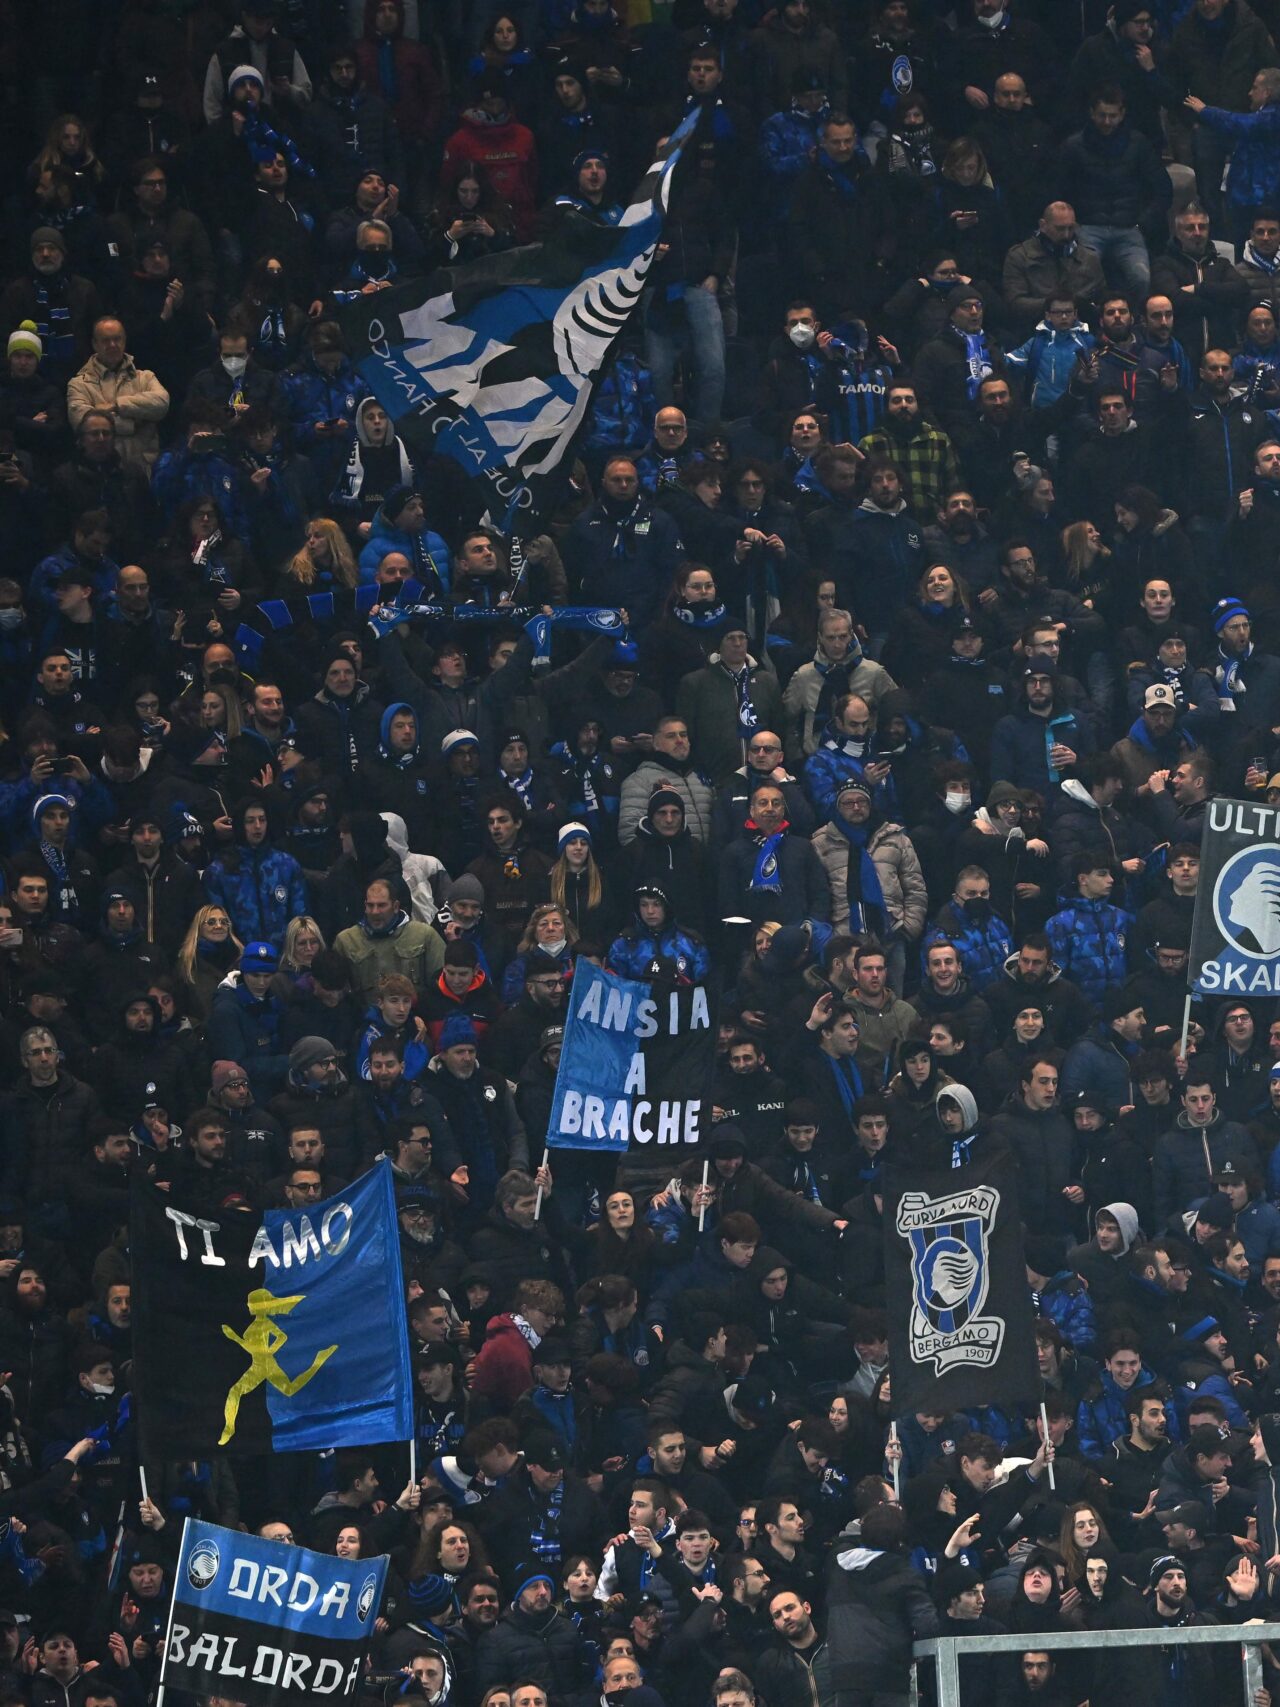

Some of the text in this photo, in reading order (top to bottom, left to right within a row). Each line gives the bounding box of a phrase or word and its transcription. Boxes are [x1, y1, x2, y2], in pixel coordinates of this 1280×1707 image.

[577, 980, 710, 1038] ANSIA
[623, 1052, 646, 1096] A
[559, 1090, 701, 1145] BRACHE
[165, 1202, 354, 1269] TI AMO
[918, 1327, 990, 1354] BERGAMO
[965, 1348, 991, 1361] 1907
[227, 1557, 351, 1619] ORDA
[168, 1623, 361, 1696] BALORDA
